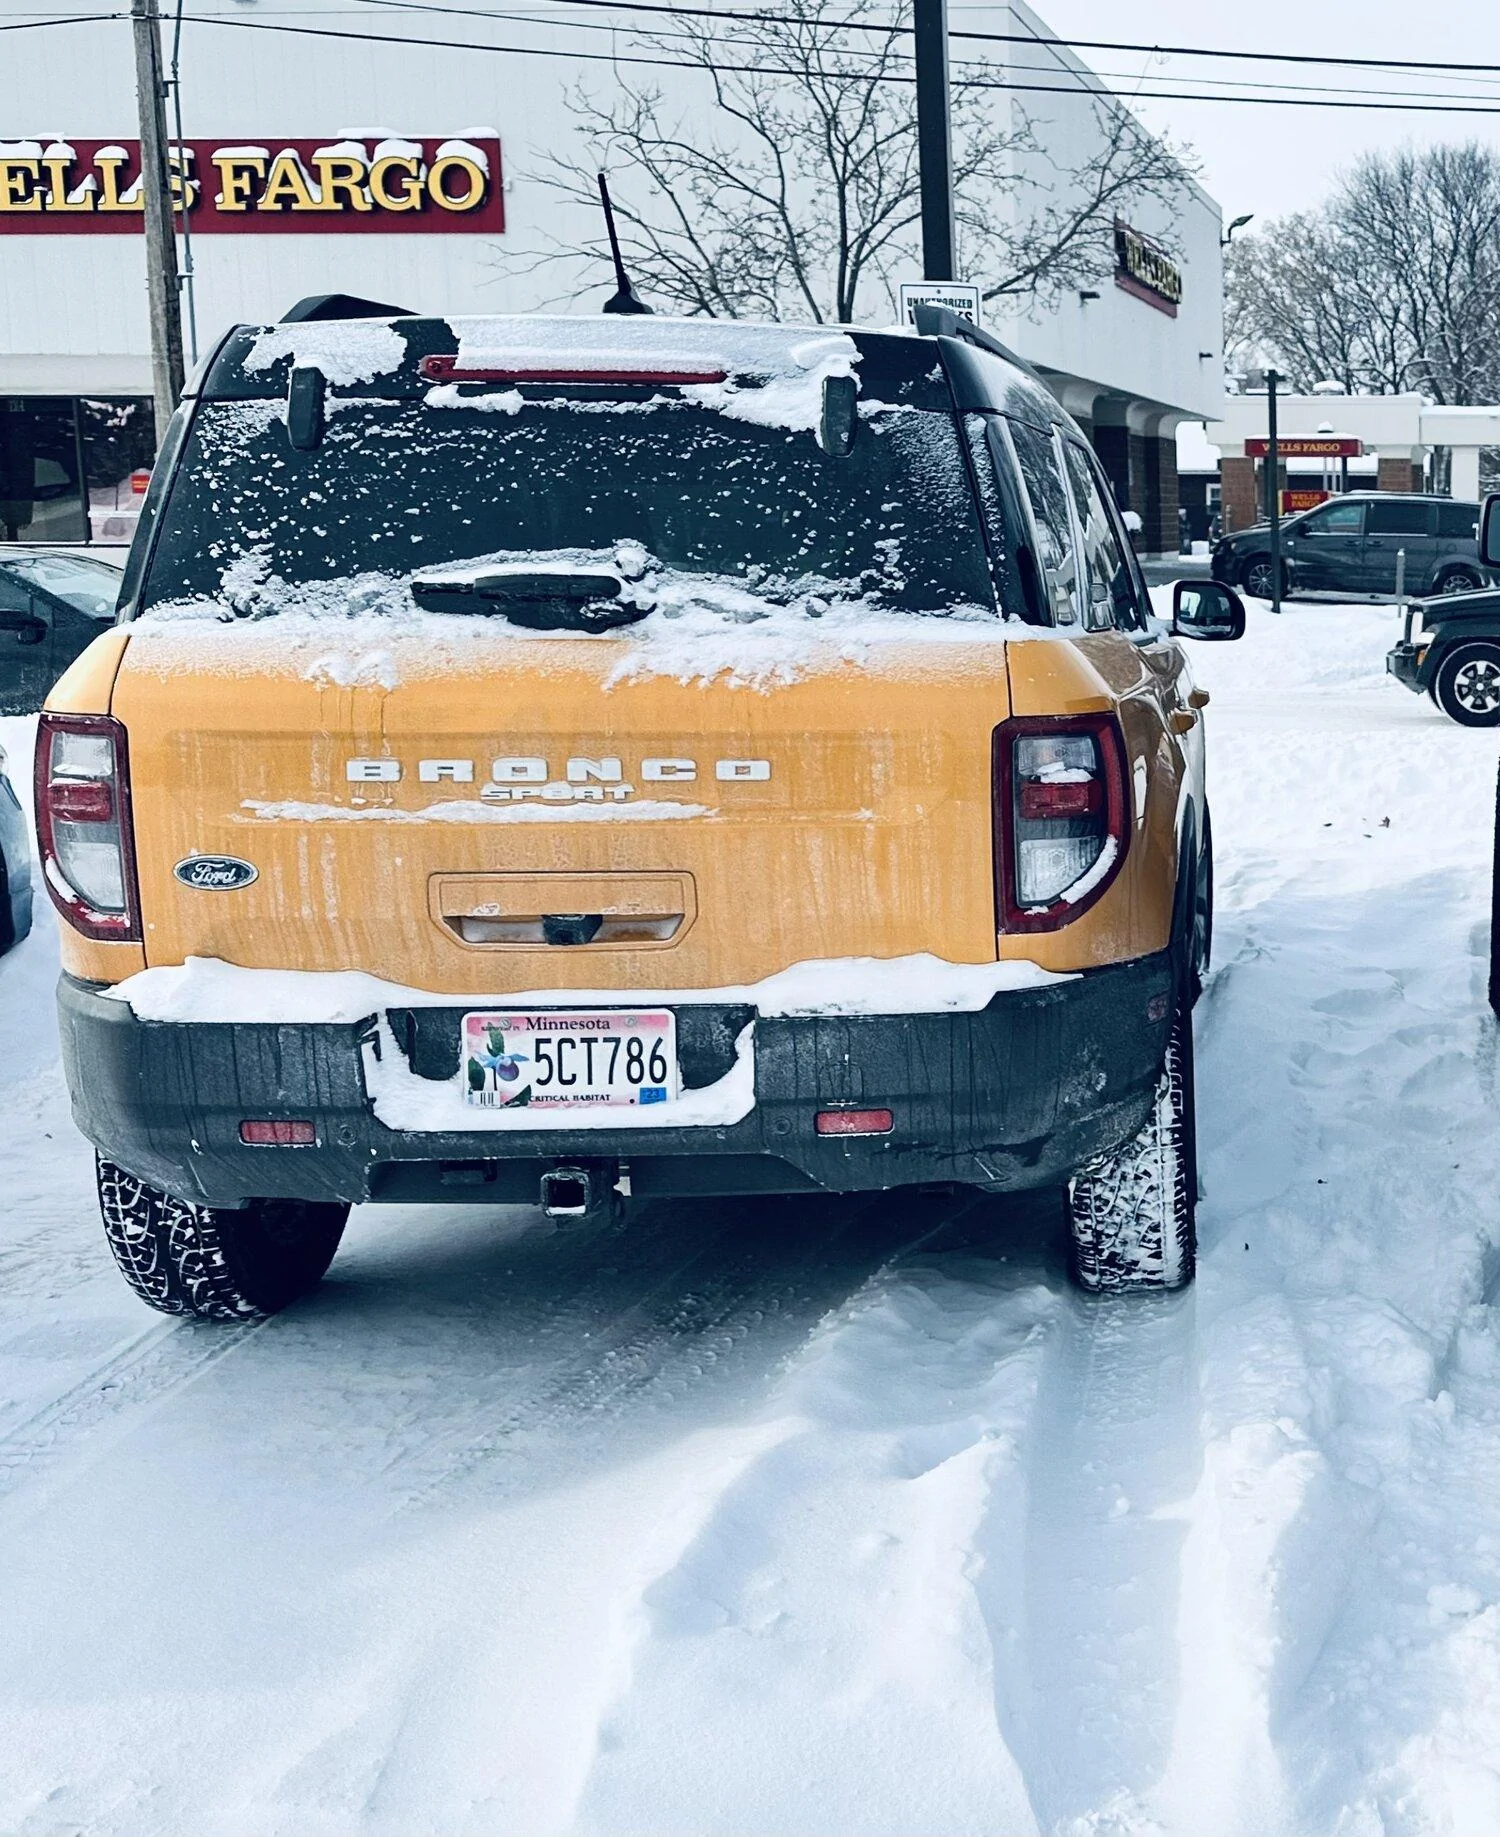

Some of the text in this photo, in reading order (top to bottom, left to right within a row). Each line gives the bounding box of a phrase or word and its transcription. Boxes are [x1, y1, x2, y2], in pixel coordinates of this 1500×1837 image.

[212, 156, 486, 211] FARGO
[1302, 443, 1340, 453] FARGO
[346, 758, 771, 783] BRONCO
[480, 783, 635, 801] SPORT
[191, 862, 237, 884] Ford
[525, 1016, 611, 1031] Minnesota
[535, 1036, 667, 1086] 5CT786
[529, 1094, 611, 1103] CRITICAL HABITAT
